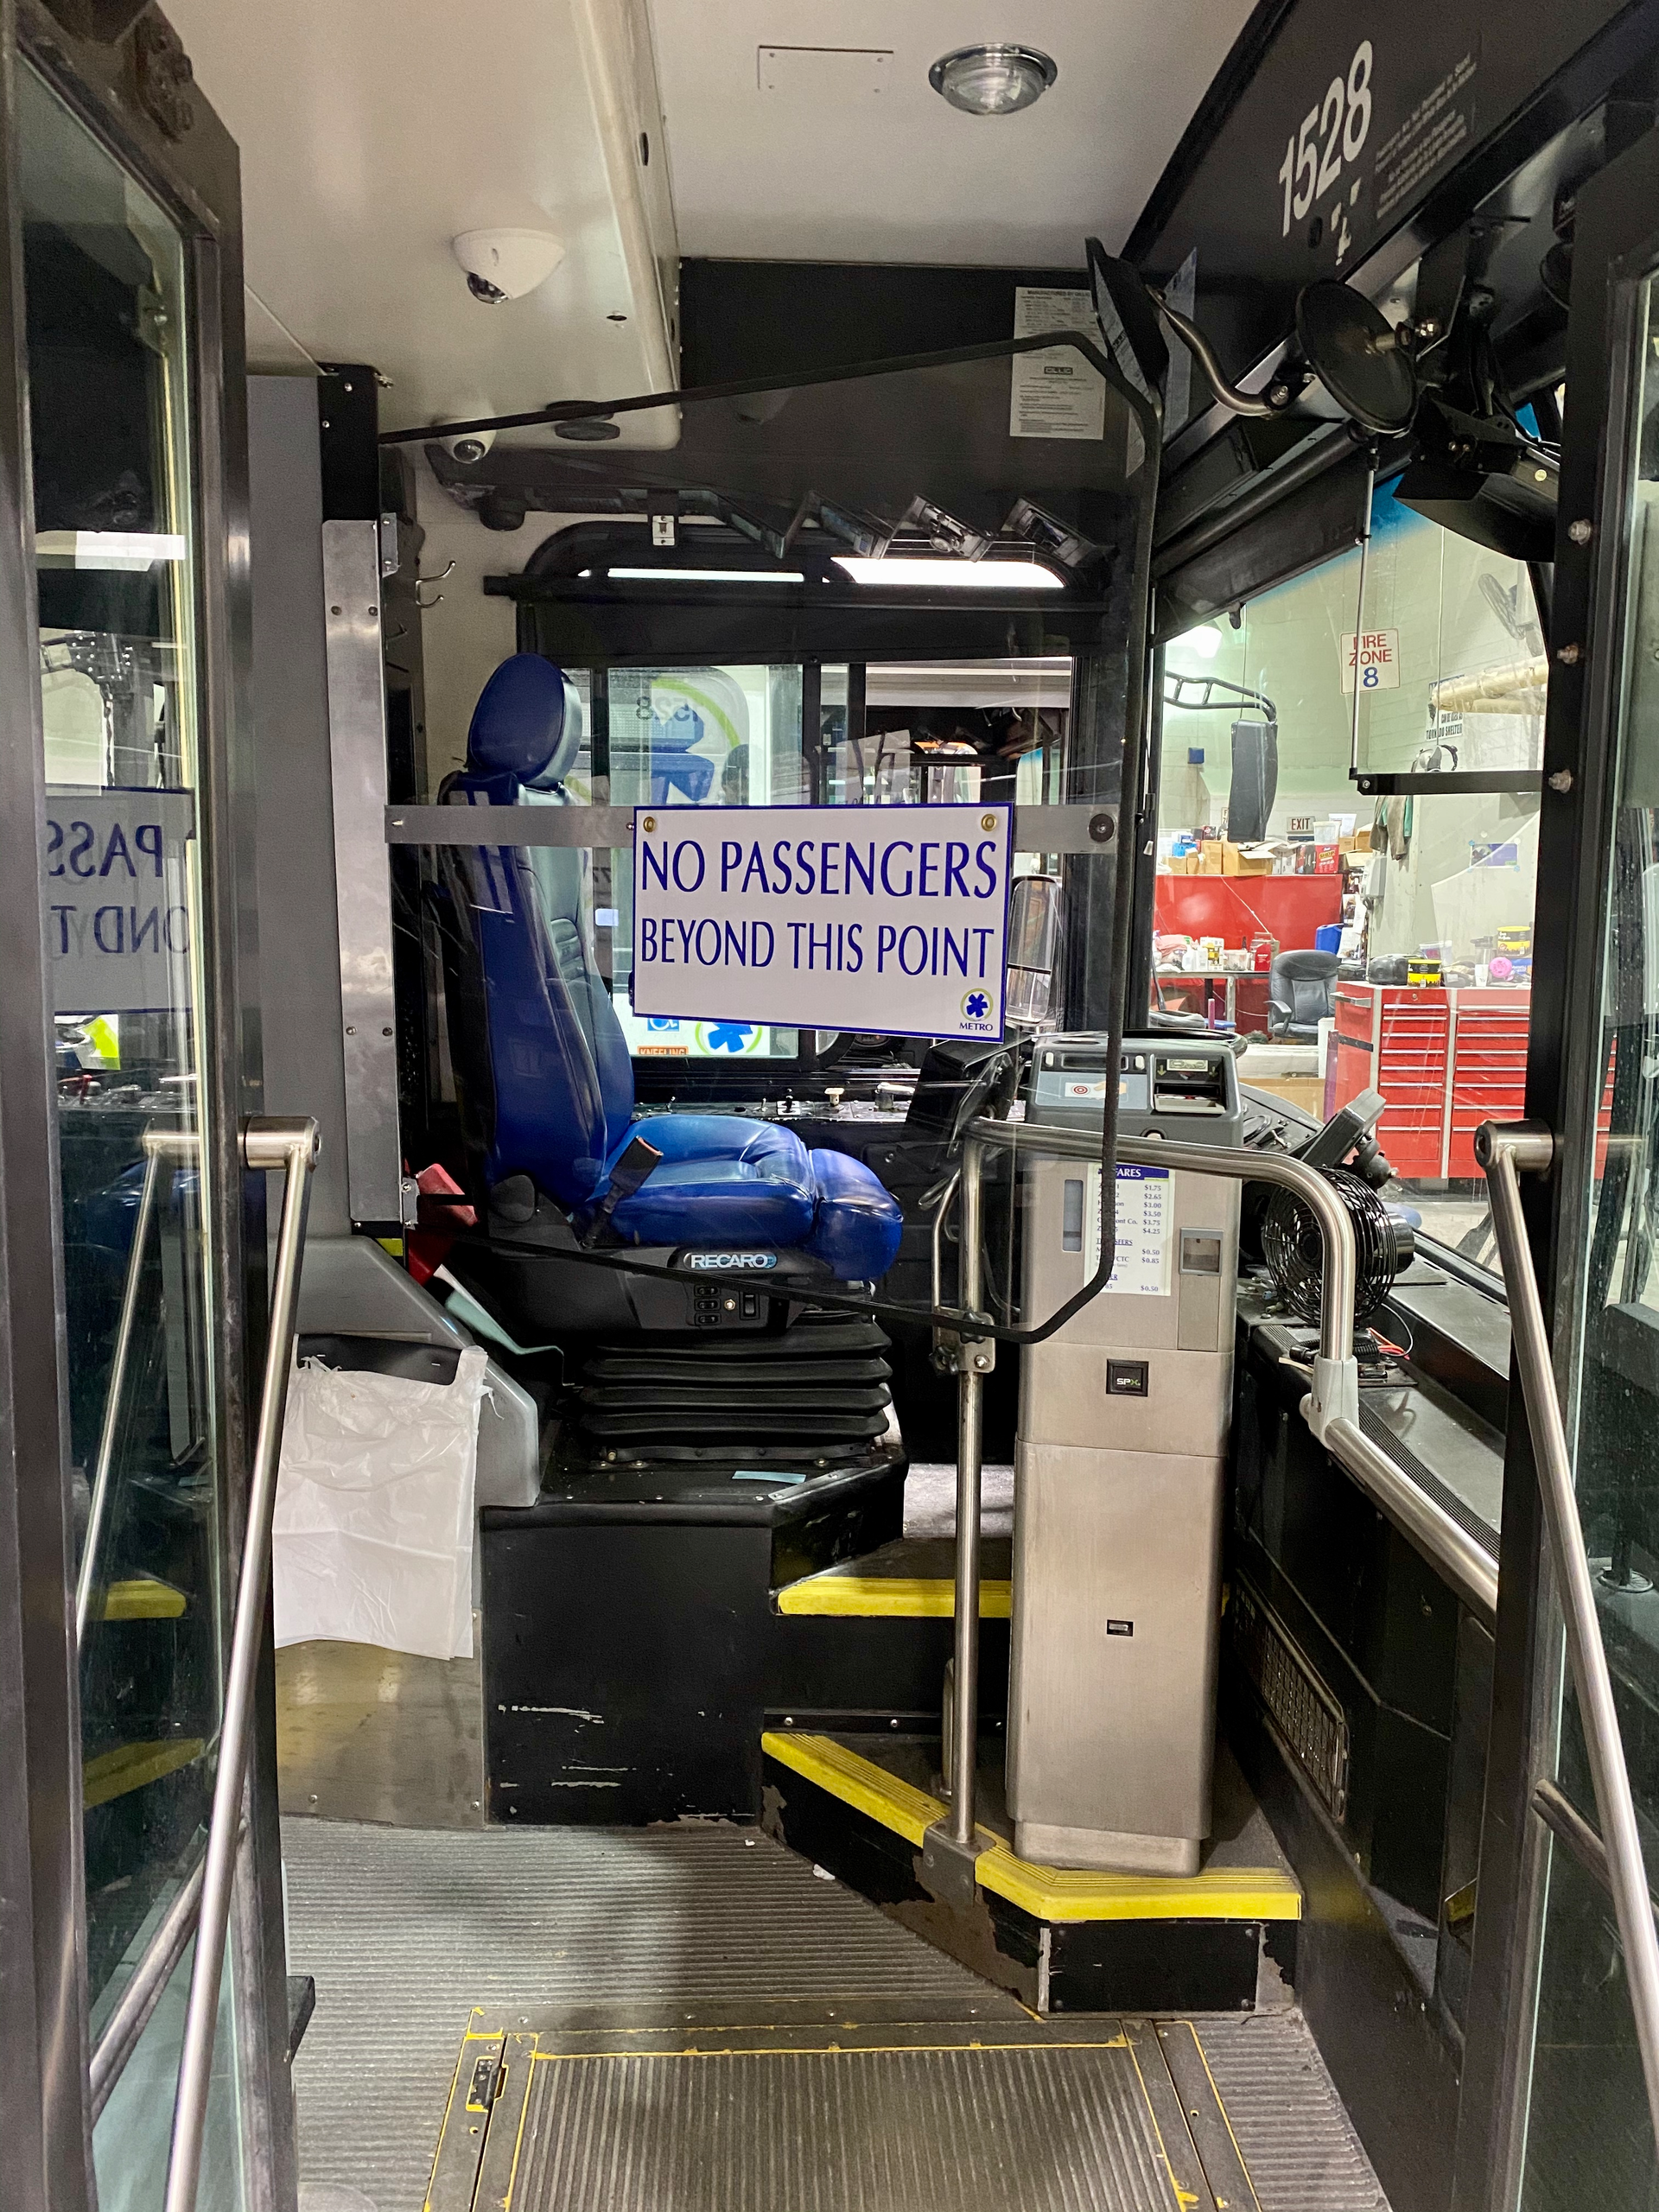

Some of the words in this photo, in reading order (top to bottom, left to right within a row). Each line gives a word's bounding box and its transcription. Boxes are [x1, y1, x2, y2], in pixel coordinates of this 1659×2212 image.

[1278, 40, 1373, 238] 1528
[1363, 666, 1379, 688] 8
[1427, 728, 1445, 741] TORNDO
[1291, 817, 1311, 830] EXIT
[641, 840, 706, 893] NO
[721, 841, 997, 899] PASSENGERS
[641, 918, 774, 968] BEYOND
[787, 922, 863, 973] THIS
[877, 925, 995, 978] POINT
[959, 1022, 994, 1032] METRO
[691, 1254, 768, 1268] RECARO
[1116, 1377, 1139, 1386] SPX
